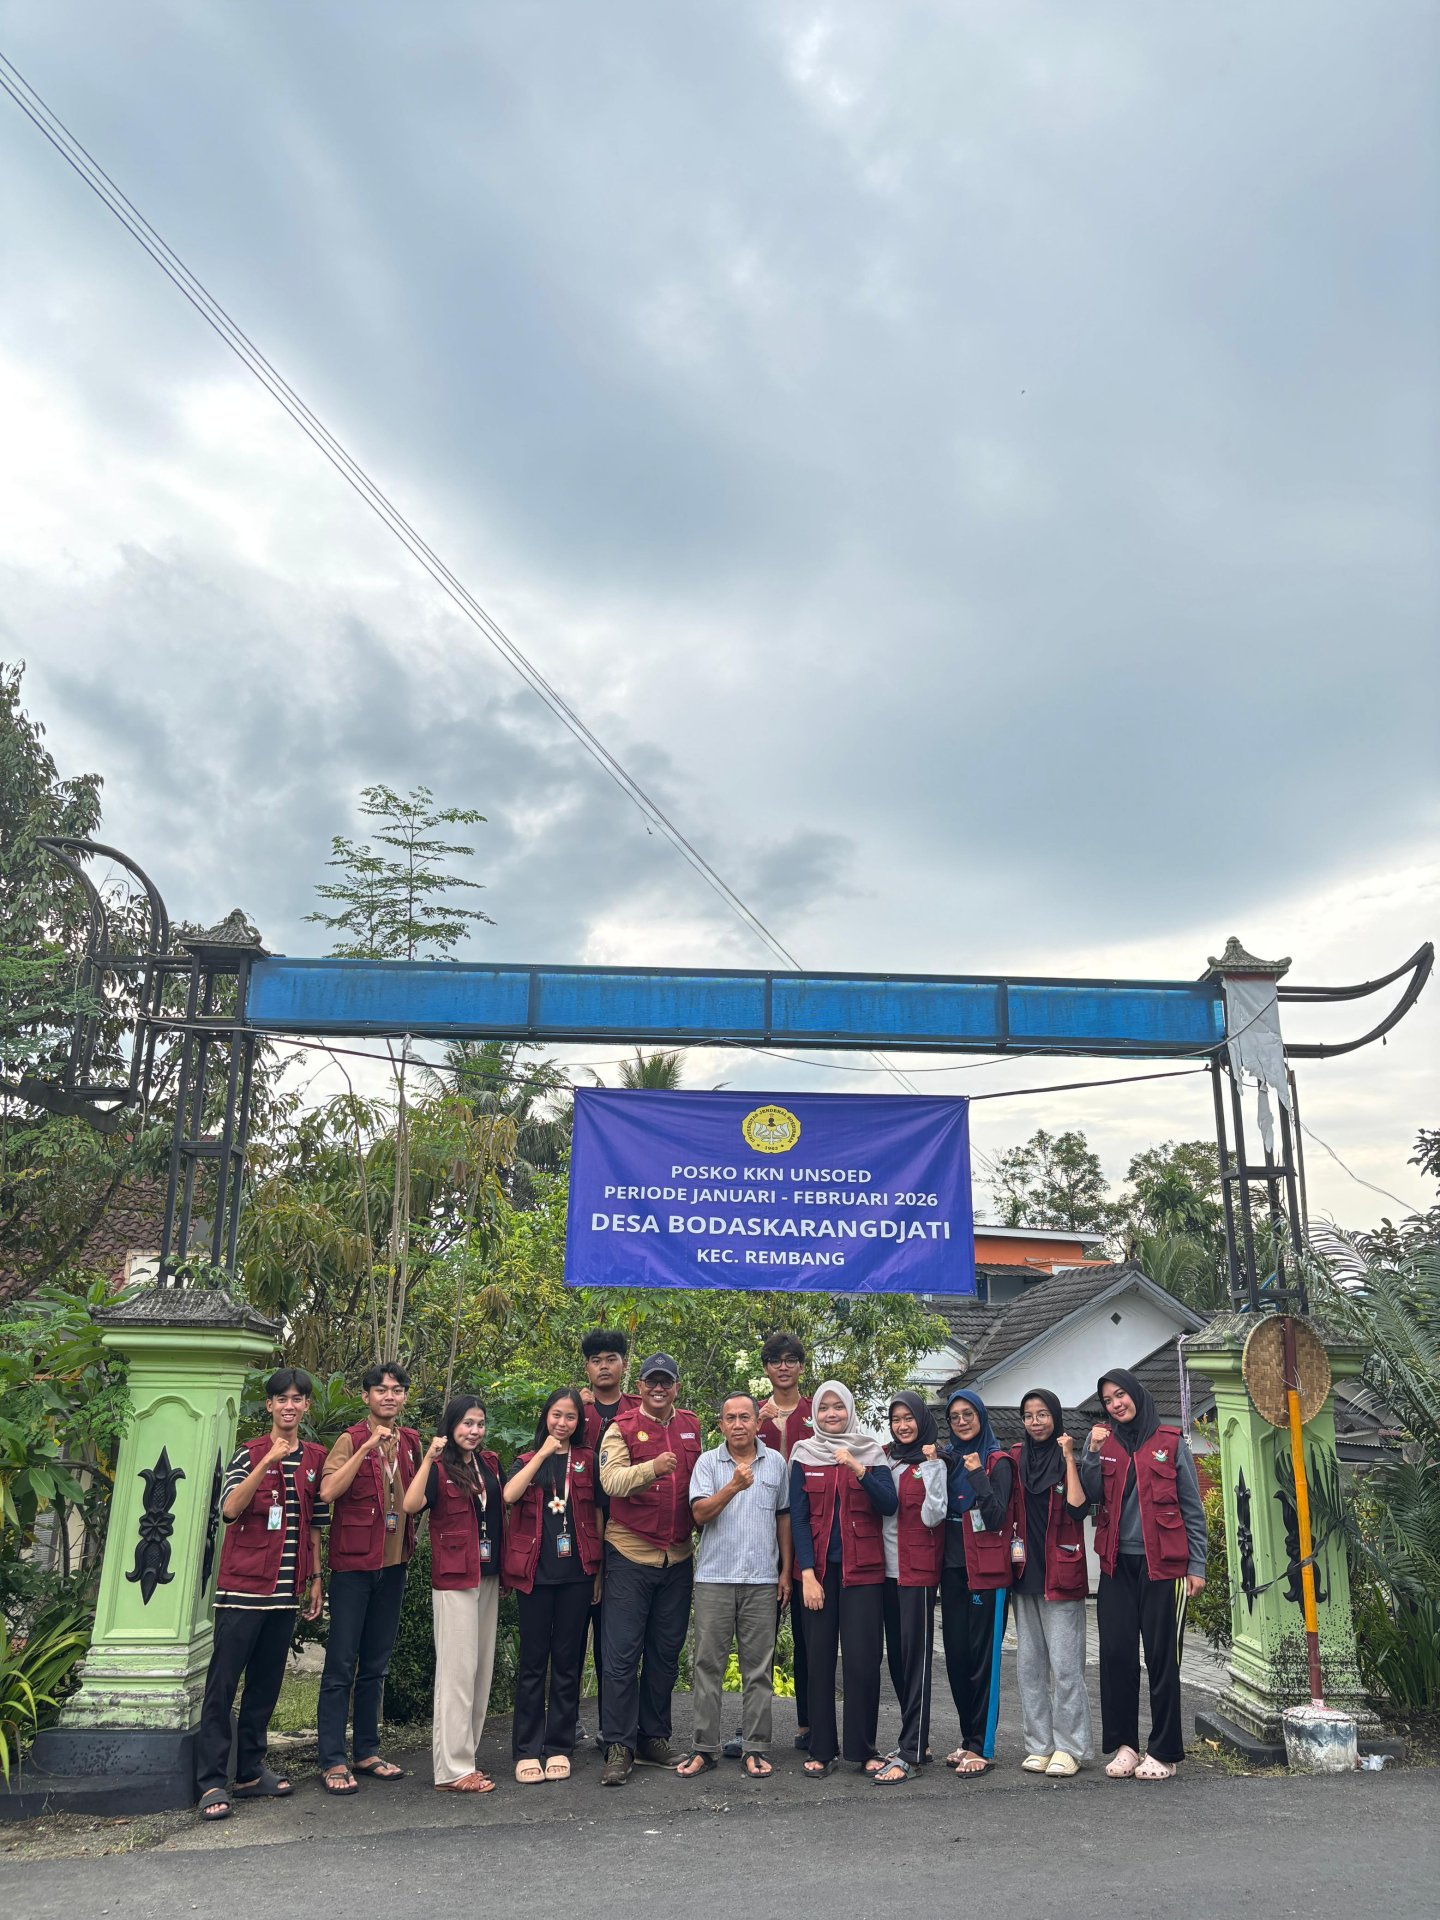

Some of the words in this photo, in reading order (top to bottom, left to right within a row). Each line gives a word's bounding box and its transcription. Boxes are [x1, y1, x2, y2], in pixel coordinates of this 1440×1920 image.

[671, 1165, 737, 1180] POSKO
[743, 1167, 784, 1181] KKN
[790, 1168, 872, 1183] UNSOED
[604, 1185, 687, 1201] PERIODE
[690, 1188, 776, 1204] JANUARI
[793, 1190, 888, 1206] FEBRUARI
[894, 1192, 938, 1207] 2026
[591, 1212, 660, 1233] DESA
[668, 1216, 950, 1243] BODASKARANGDJATI
[697, 1248, 739, 1263] KEC.
[745, 1250, 846, 1266] REMBANG
